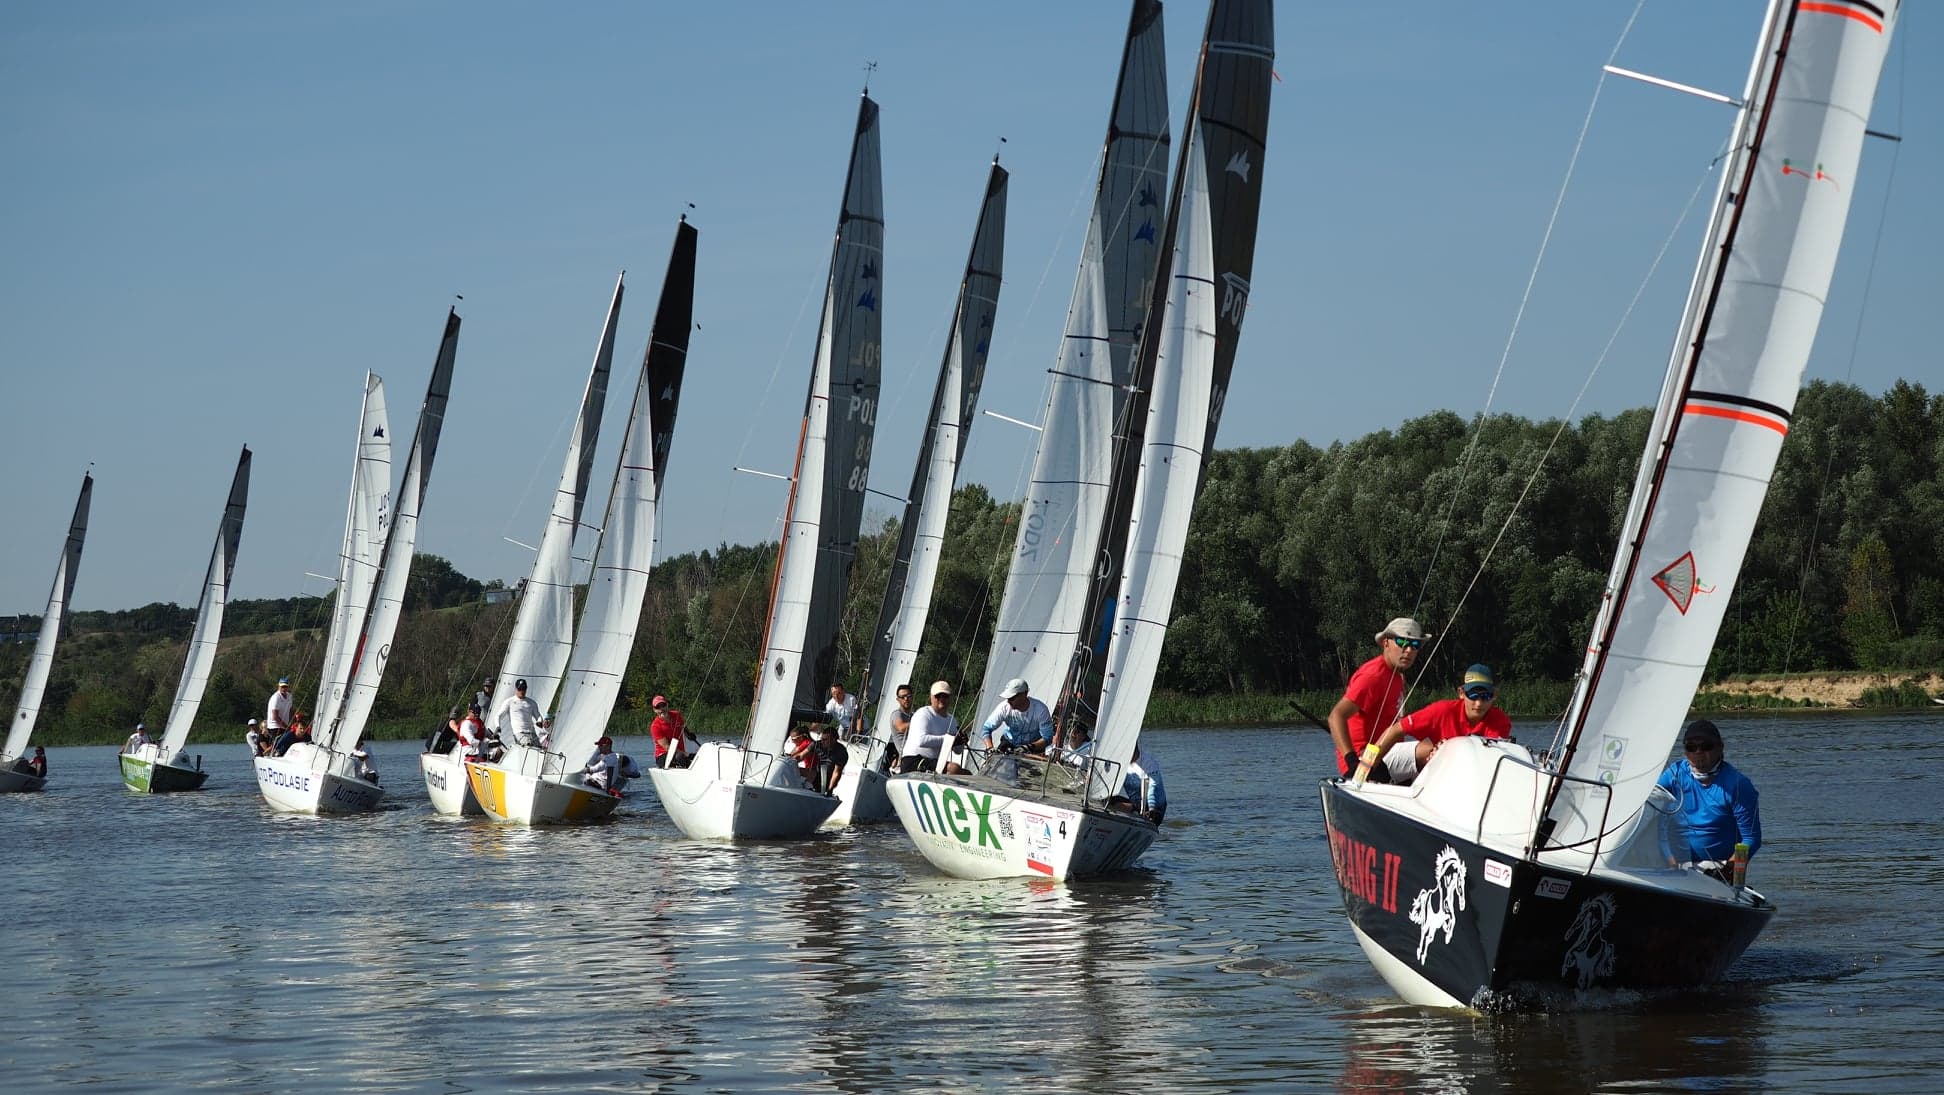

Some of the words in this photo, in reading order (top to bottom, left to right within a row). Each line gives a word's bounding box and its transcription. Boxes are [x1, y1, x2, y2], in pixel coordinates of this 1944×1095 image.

[848, 465, 868, 493] 88
[268, 767, 310, 792] PODLASIE
[1058, 820, 1067, 840] 4
